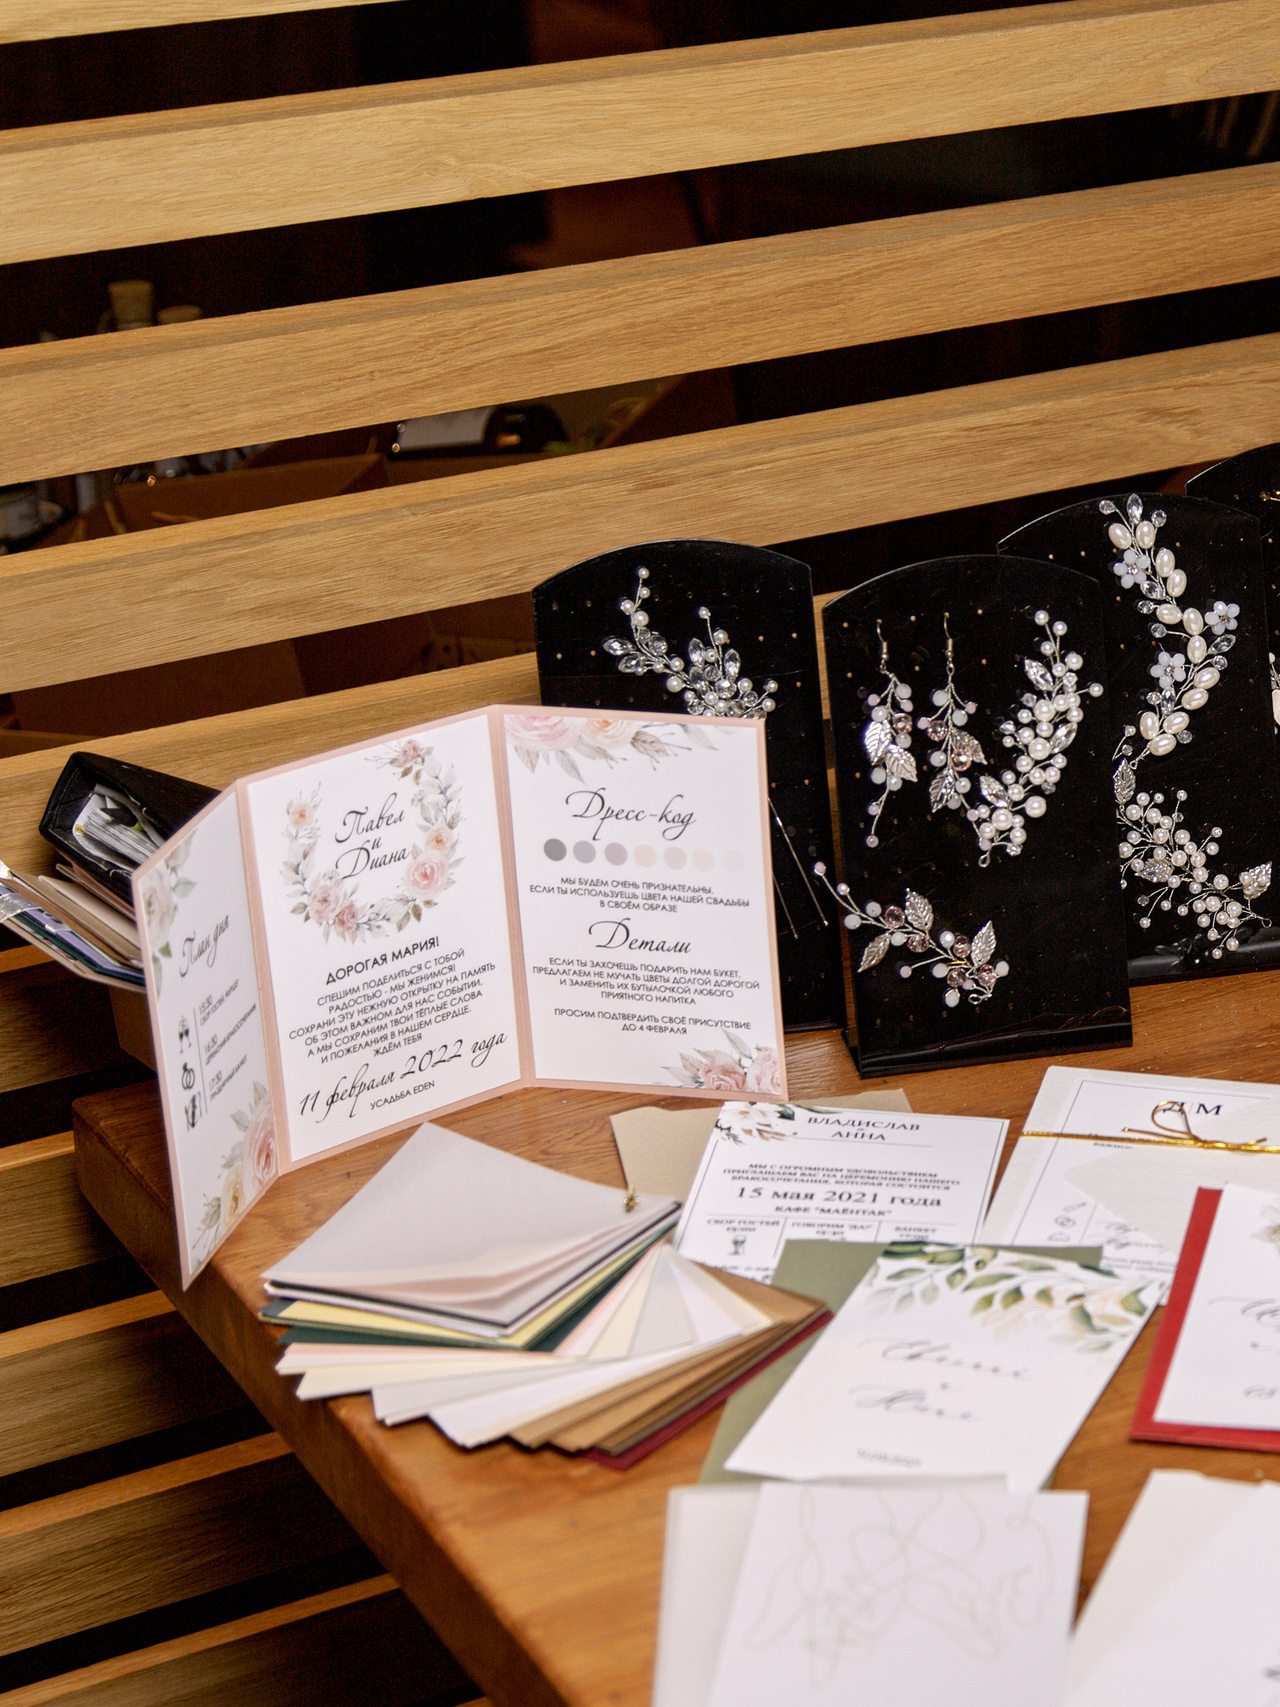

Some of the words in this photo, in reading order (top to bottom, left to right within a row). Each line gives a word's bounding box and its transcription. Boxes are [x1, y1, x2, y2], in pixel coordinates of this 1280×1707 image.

[334, 792, 404, 844] Павел
[566, 787, 696, 841] Дресс-код
[372, 837, 382, 850] и
[335, 840, 410, 880] Диана
[530, 884, 555, 894] ЕСЛИ
[556, 886, 568, 895] ТЫ
[570, 887, 639, 900] ИСПОЛЬЗУЕШЬ
[641, 892, 668, 901] ЦВЕТА
[670, 895, 704, 904] НАШЕЙ
[705, 896, 750, 907] СВАДЬБЫ
[578, 877, 609, 887] БУДЕМ
[610, 879, 640, 889] ОЧЕНЬ
[642, 881, 714, 894] ПРИЗНАТЕЛЬНЫ,
[600, 900, 606, 908] В
[607, 900, 640, 910] СВОЁМ
[642, 902, 677, 913] ОБРАЗЕ
[588, 918, 692, 954] Детали
[326, 953, 388, 985] ДОРОГАЯ
[392, 936, 439, 962] МАРИЯ!
[549, 957, 574, 966] ЕСЛИ
[576, 959, 587, 968] ТЫ
[590, 960, 638, 971] ЗАХОЧЕШЬ
[640, 963, 688, 975] ПОДАРИТЬ
[713, 969, 741, 978] БУКЕТ,
[317, 985, 360, 1006] СПЕШИМ
[362, 963, 422, 991] ПОДЕЛИТЬСЯ
[424, 960, 432, 970] С
[434, 949, 464, 966] ТОБОЙ
[328, 989, 382, 1014] РАДОСТЬЮ
[390, 981, 405, 993] МЫ
[407, 964, 456, 988] ЖЕНИМСЯ!
[532, 966, 592, 977] ПРЕДЛАГАЕМ
[593, 970, 604, 979] НЕ
[606, 972, 641, 981] МУЧАТЬ
[643, 974, 670, 983] ЦВЕТЫ
[672, 976, 711, 986] ДОЛГОЙ
[713, 979, 760, 989] ДОРОГОЙ
[569, 978, 615, 989] ЗАМЕНИТЬ
[631, 983, 691, 994] БУТЫЛОЧКОЙ
[693, 988, 734, 998] ЛЮБОГО
[289, 1017, 336, 1040] СОХРАНИ
[338, 1010, 355, 1023] ЭТУ
[357, 995, 398, 1016] НЕЖНУЮ
[400, 979, 444, 1001] ОТКРЫТКУ
[446, 975, 459, 985] НА
[460, 963, 496, 980] ПАМЯТЬ
[601, 991, 654, 1002] ПРИЯТНОГО
[655, 995, 696, 1005] НАПИТКА
[304, 1034, 318, 1046] ОБ
[320, 1025, 348, 1041] ЭТОМ
[350, 1009, 393, 1031] ВАЖНОМ
[394, 1001, 413, 1016] ДЛЯ
[415, 994, 435, 1008] НАС
[436, 979, 482, 1000] СОБЫТИИ,
[308, 1049, 314, 1057] А
[316, 1042, 332, 1054] МЫ
[334, 1022, 388, 1048] СОХРАНИМ
[390, 1013, 414, 1028] ТВОИ
[415, 1001, 448, 1019] ТЁПЛЫЕ
[450, 990, 482, 1007] СЛОВА
[554, 1008, 596, 1018] ПРОСИМ
[597, 1011, 660, 1023] ПОДТВЕРДИТЬ
[661, 1015, 686, 1025] СВОЁ
[688, 1017, 751, 1030] ПРИСУТСТВИЕ
[321, 1055, 328, 1064] И
[330, 1033, 388, 1061] ПОЖЕЛАНИЯ
[390, 1031, 396, 1040] В
[398, 1018, 432, 1037] НАШЕМ
[434, 1006, 471, 1024] СЕРДЦЕ.
[622, 1023, 637, 1032] ДО
[646, 1025, 687, 1035] ФЕВРАЛЯ
[373, 1041, 402, 1057] ЖДЁМ
[403, 1032, 422, 1046] ТЕБЯ
[300, 1090, 320, 1116] 11
[316, 1063, 396, 1124] февраля
[400, 1039, 464, 1080] 2022
[470, 1033, 508, 1068] года
[370, 1089, 412, 1110] УСАДЬБА
[413, 1080, 435, 1095] EDEN
[808, 1117, 920, 1131] ВЛАДИСЛАВ
[832, 1131, 885, 1141] АННА
[739, 1187, 762, 1198] 15
[772, 1191, 814, 1200] мая
[824, 1191, 878, 1203] 2021
[890, 1196, 941, 1207] года
